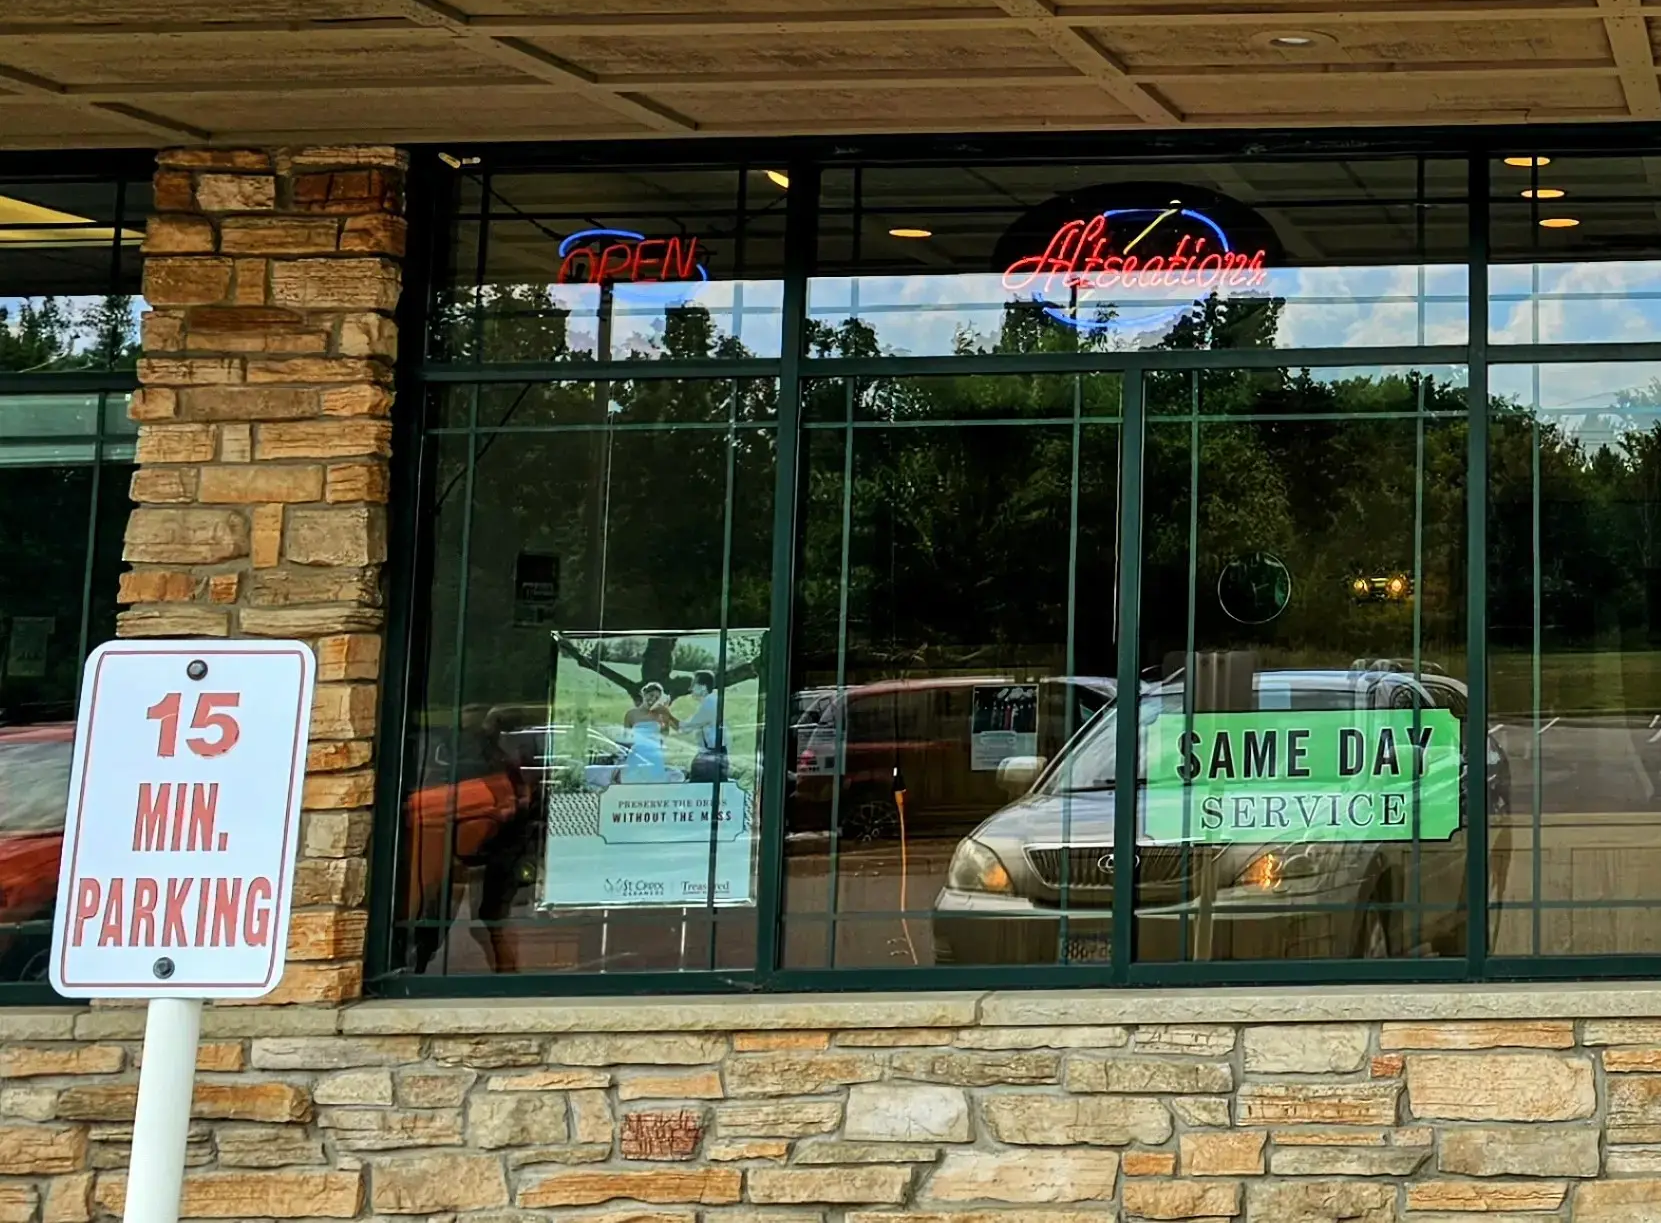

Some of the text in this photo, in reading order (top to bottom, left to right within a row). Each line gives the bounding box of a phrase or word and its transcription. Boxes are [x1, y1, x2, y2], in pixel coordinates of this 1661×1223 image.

[557, 236, 698, 285] OPEN
[146, 692, 241, 758] 15
[1177, 726, 1434, 781] SAME DAY
[132, 783, 229, 852] MIN.
[612, 810, 732, 823] WITHOUT THE MSS
[618, 799, 728, 809] PRESERVE THE DRS
[1201, 793, 1407, 829] SERVICE
[71, 876, 272, 948] PARKING
